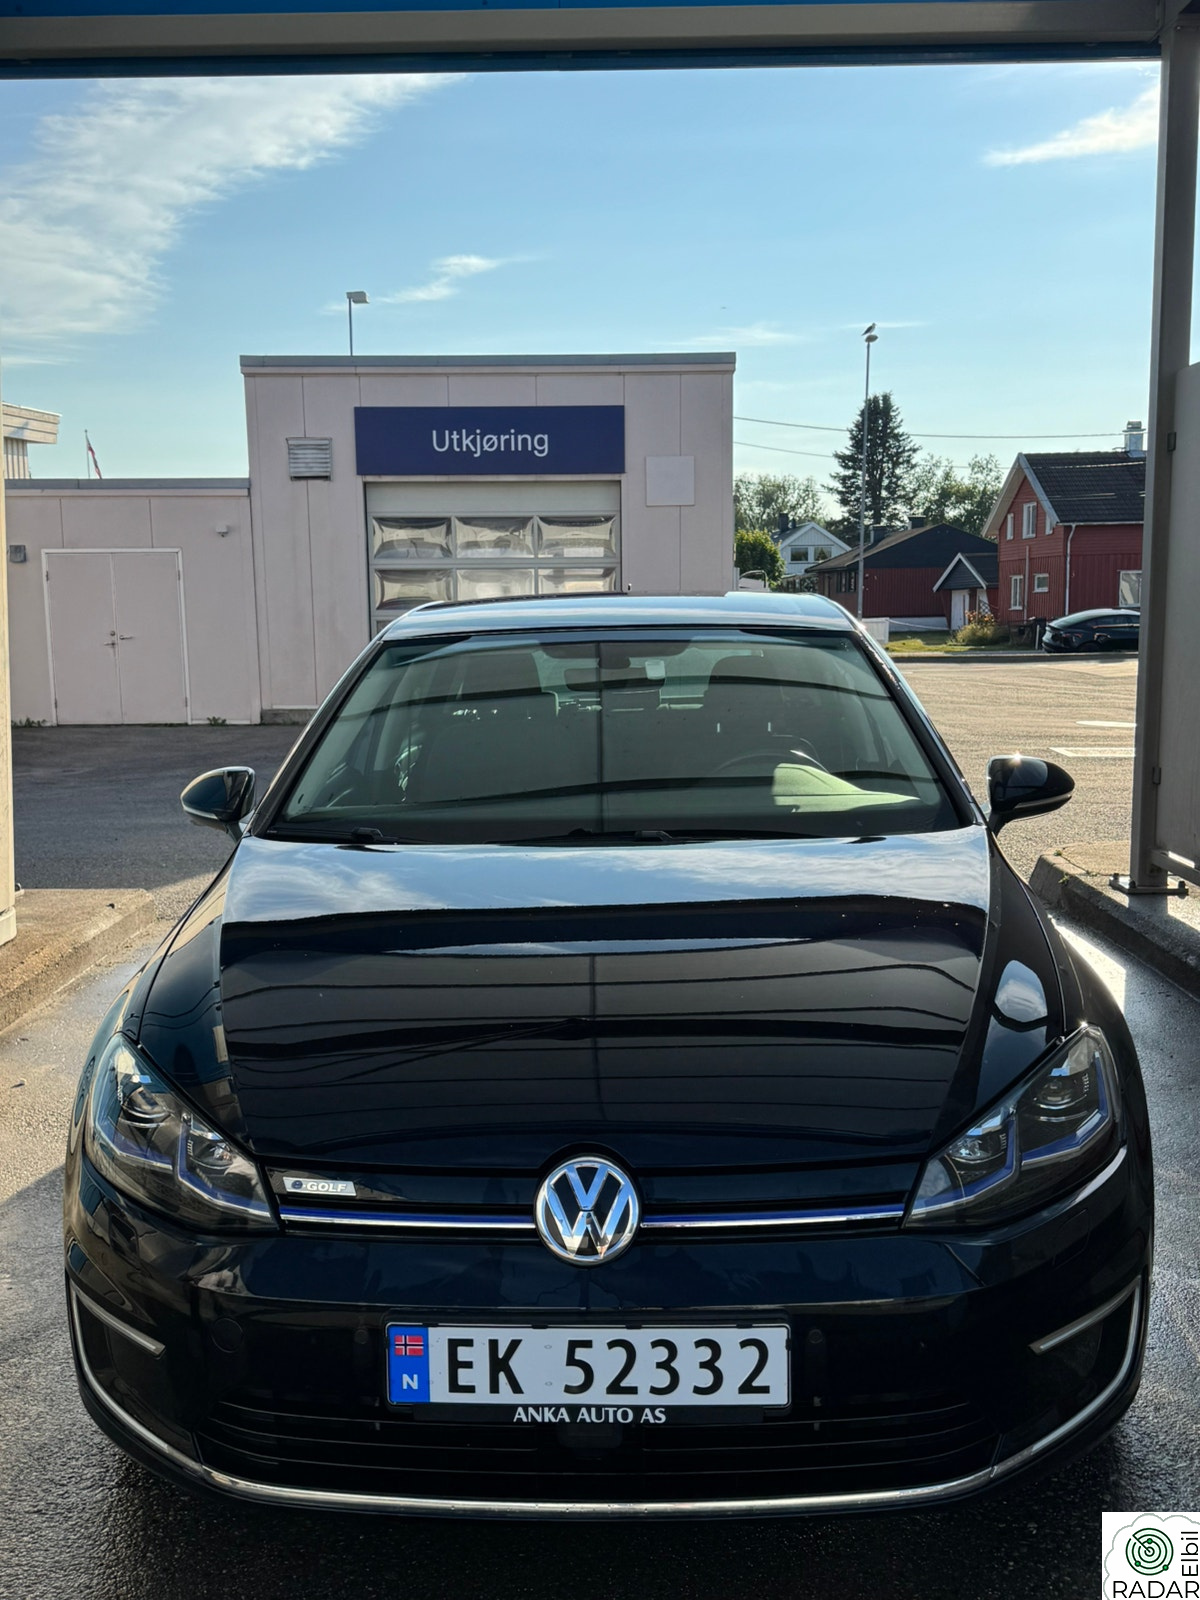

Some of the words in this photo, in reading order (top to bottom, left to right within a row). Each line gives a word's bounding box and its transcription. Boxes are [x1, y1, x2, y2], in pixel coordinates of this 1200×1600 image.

[432, 429, 549, 457] Utkjøring
[446, 1338, 524, 1394] EK
[563, 1338, 771, 1396] 52332
[402, 1374, 418, 1390] N
[513, 1407, 570, 1423] ANKA
[576, 1407, 634, 1424] AUTO
[640, 1407, 666, 1424] AS
